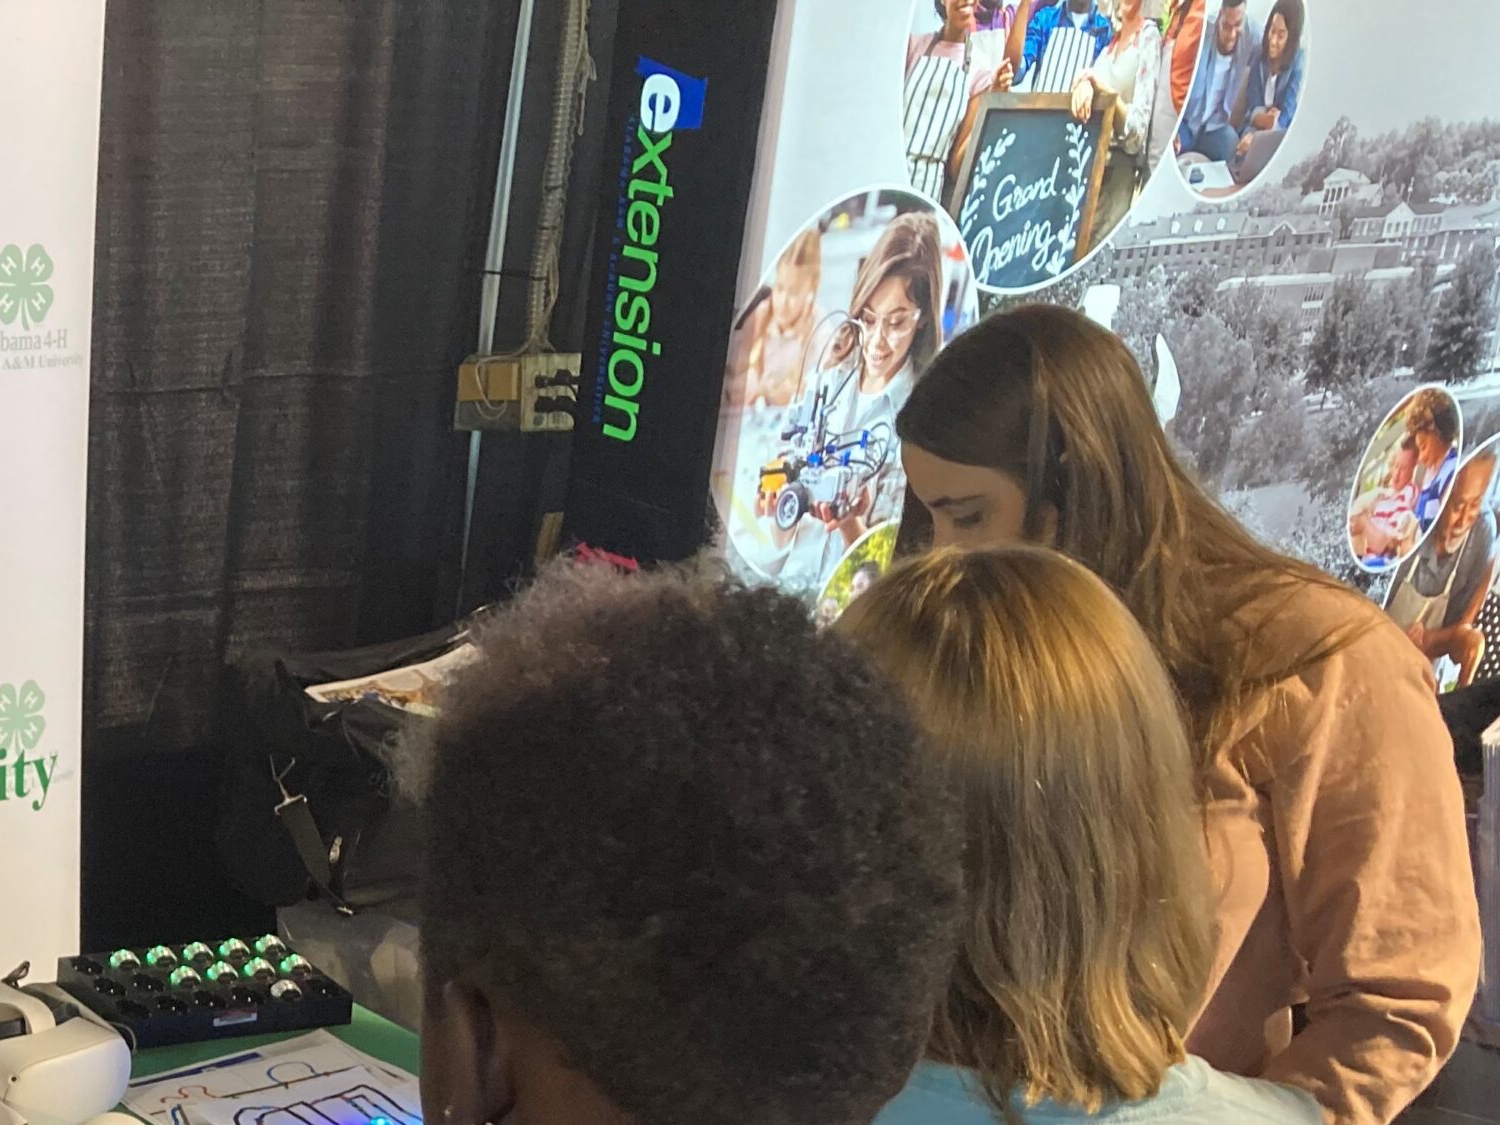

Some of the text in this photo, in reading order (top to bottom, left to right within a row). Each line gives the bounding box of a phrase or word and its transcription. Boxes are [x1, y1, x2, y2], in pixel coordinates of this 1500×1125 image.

[993, 157, 1060, 221] Grand
[602, 73, 681, 442] extension
[969, 219, 1056, 285] Opening
[43, 328, 68, 349] 4-H
